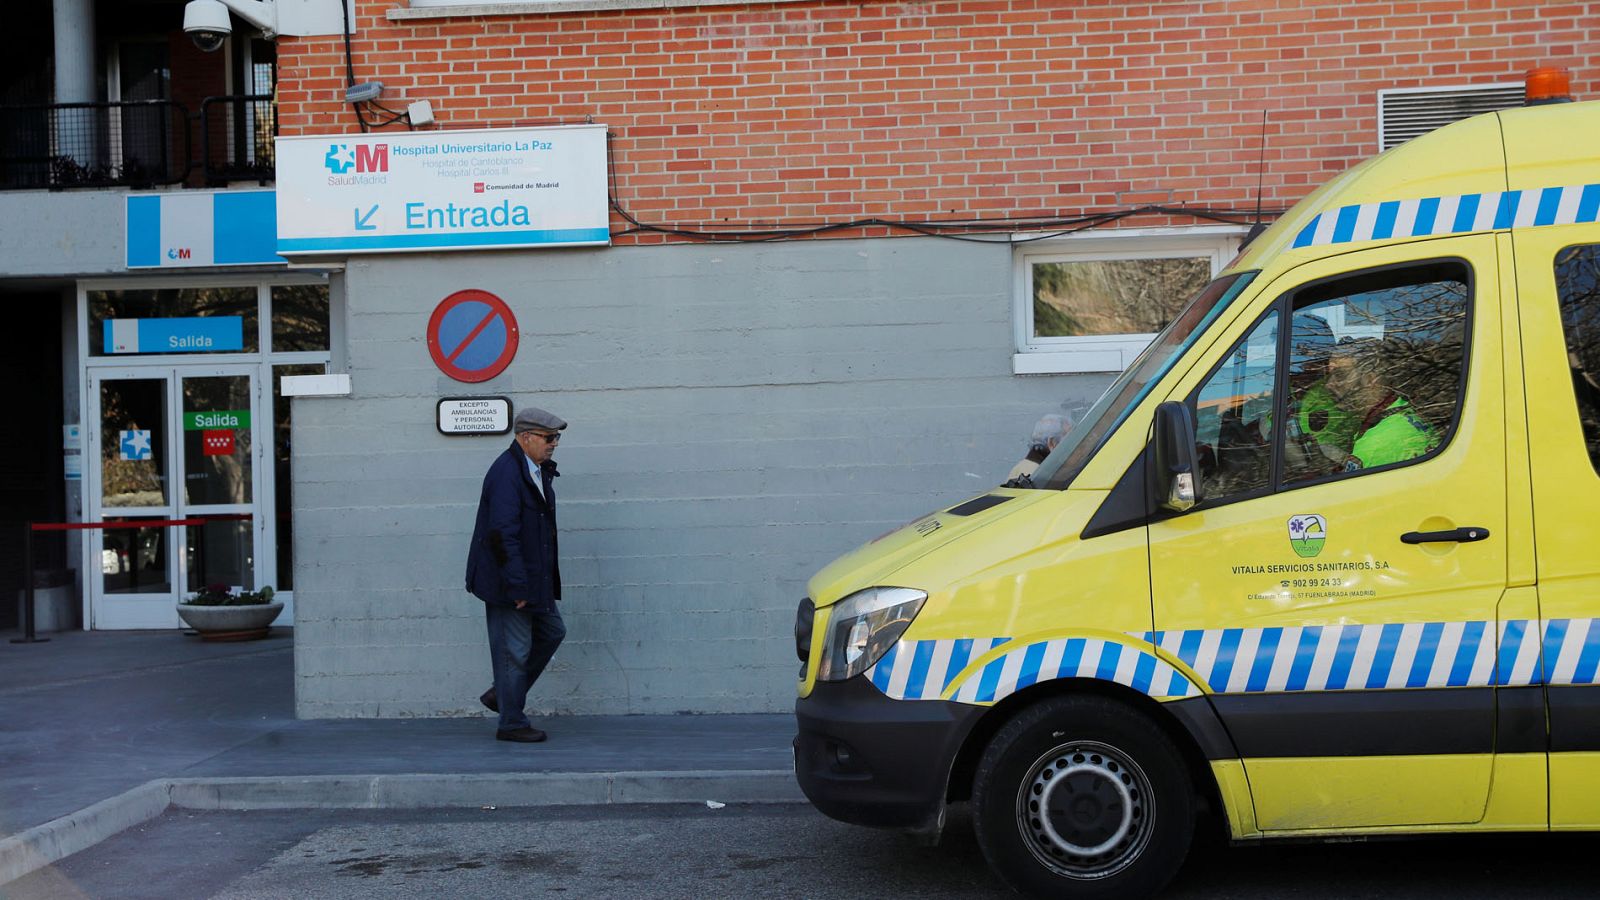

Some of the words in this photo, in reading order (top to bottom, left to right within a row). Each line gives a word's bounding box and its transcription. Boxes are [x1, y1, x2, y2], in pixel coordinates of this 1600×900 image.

[393, 144, 438, 157] Hospital
[442, 142, 512, 154] Universitario
[515, 141, 529, 151] La
[532, 140, 552, 150] Paz
[356, 144, 388, 172] M
[422, 159, 456, 169] Hospital
[458, 158, 468, 167] de
[471, 156, 523, 166] Cantoblanco
[437, 168, 471, 178] Hospital
[473, 167, 499, 176] Carlos
[328, 175, 387, 186] SaludMadrid
[405, 199, 531, 229] Entrada
[179, 248, 191, 259] M
[169, 335, 212, 348] Salida
[195, 414, 239, 428] Salida
[1232, 565, 1266, 575] VITALIA
[1268, 563, 1314, 574] SERVICIOS
[1316, 562, 1373, 572] SANITARIOS,
[1375, 561, 1389, 570] S.A
[1293, 579, 1307, 588] 902
[1309, 579, 1319, 587] 99
[1321, 579, 1330, 587] 24
[1332, 578, 1342, 587] 33
[1305, 591, 1348, 599] FUENLABRADA
[1349, 590, 1377, 598] (MADRID)
